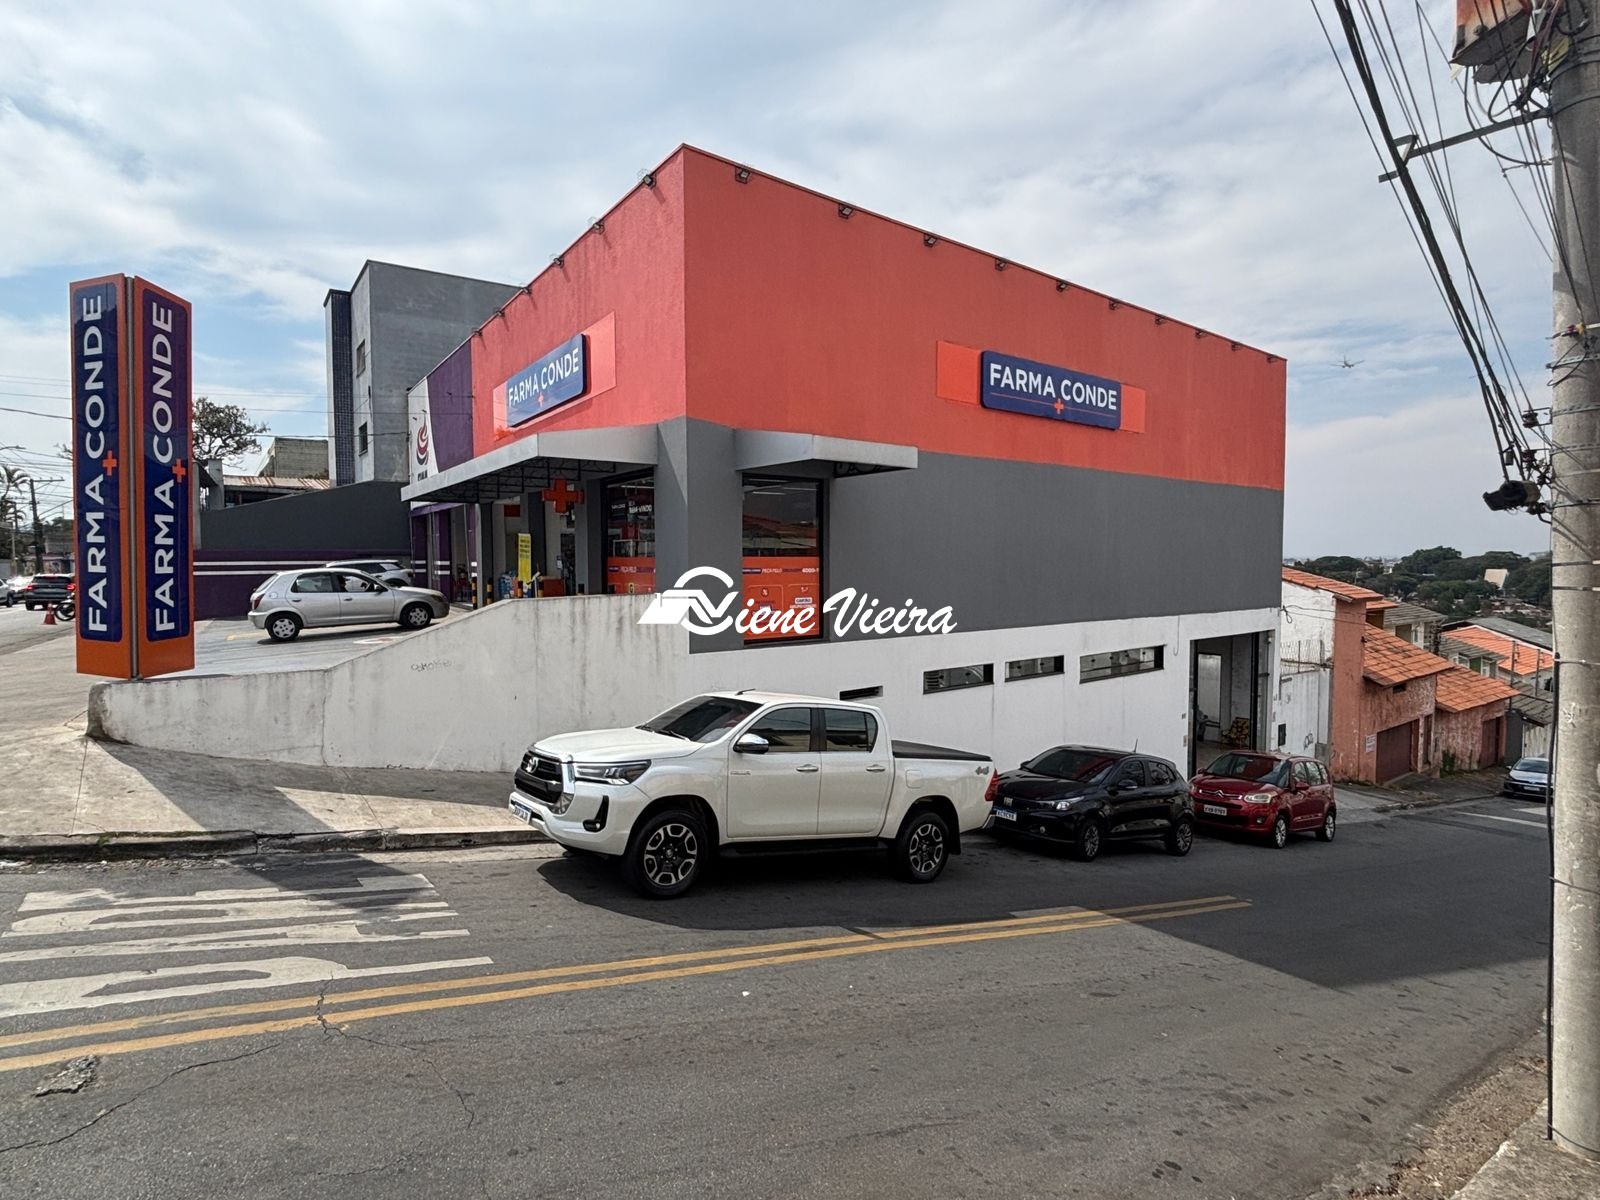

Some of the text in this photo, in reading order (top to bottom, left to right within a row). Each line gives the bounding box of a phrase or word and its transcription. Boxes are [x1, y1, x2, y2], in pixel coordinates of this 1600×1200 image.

[82, 295, 107, 632] FARMA CONDE
[152, 302, 175, 631] FARMA CONDE
[508, 347, 579, 408] FARMA CONDE
[989, 362, 1117, 410] FARMA CONDE
